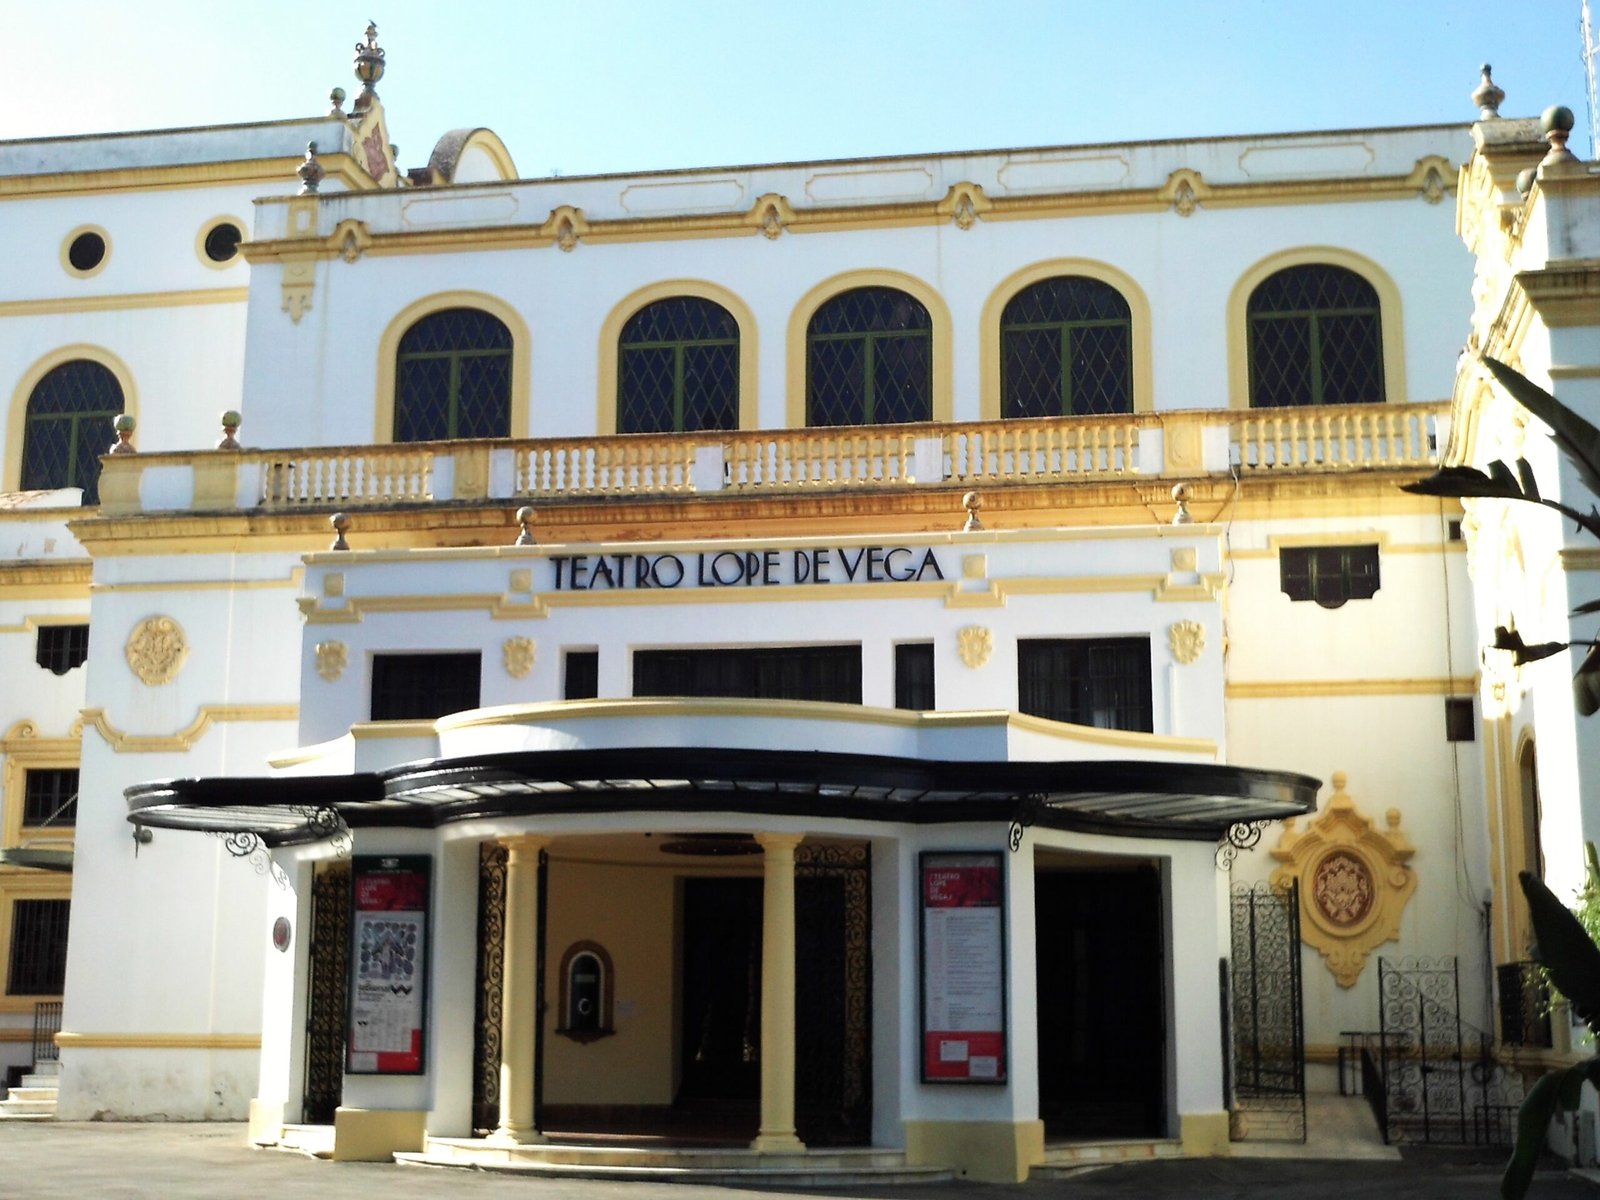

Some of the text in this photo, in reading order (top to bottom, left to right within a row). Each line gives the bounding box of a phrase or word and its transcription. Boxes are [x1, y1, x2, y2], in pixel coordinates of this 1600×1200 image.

[548, 547, 945, 590] TEATRO LOPE DE VEGA
